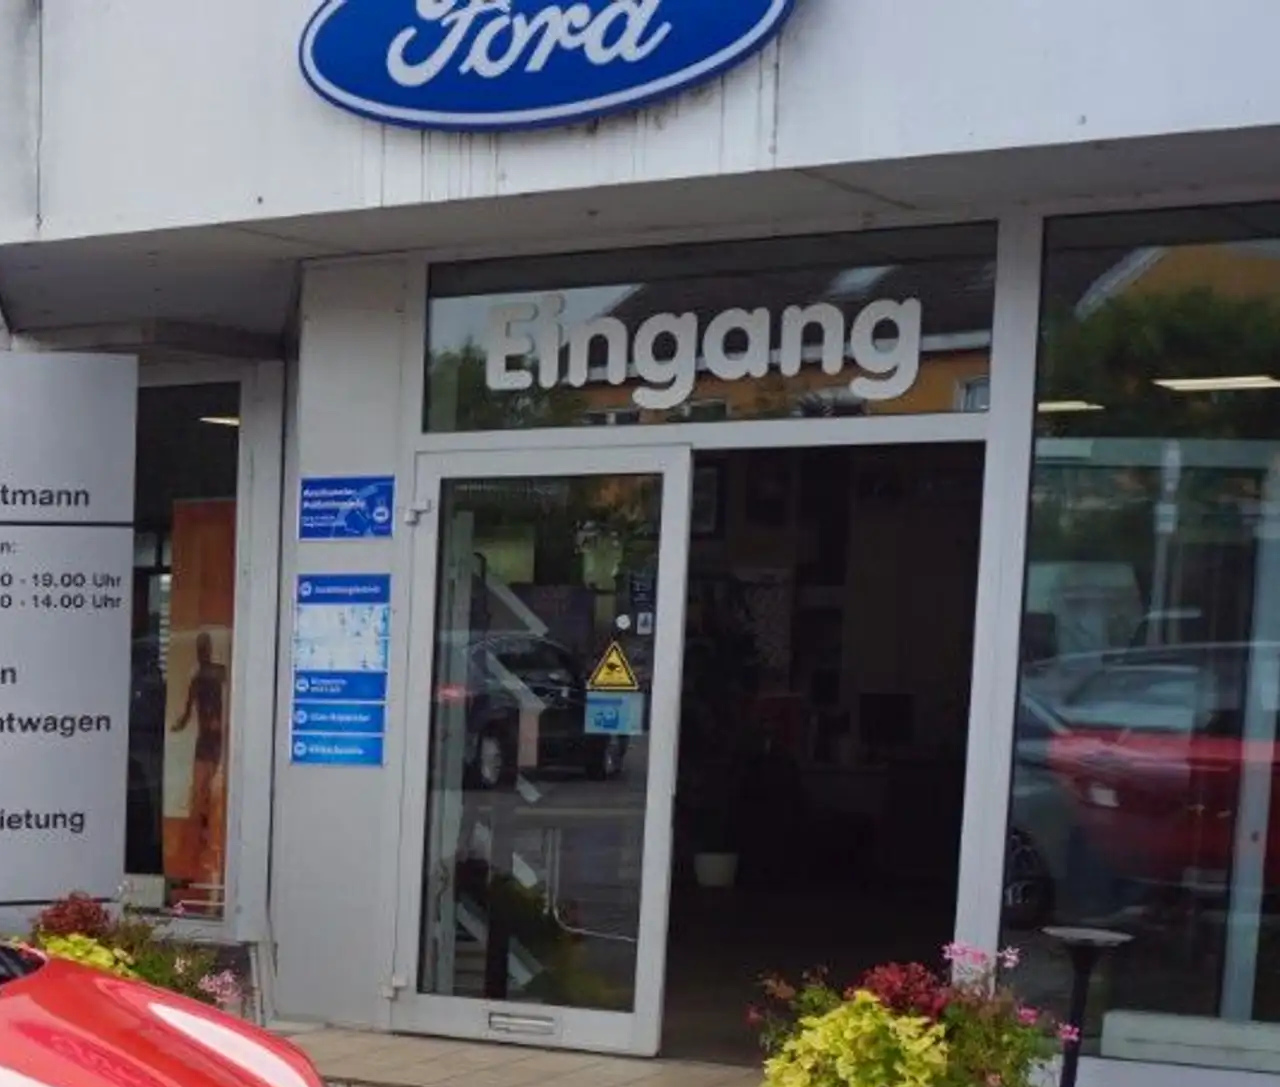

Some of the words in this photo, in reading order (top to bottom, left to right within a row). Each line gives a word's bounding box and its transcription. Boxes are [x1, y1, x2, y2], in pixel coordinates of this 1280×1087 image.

[485, 293, 922, 411] Eingang
[92, 573, 123, 588] Uhr
[32, 594, 87, 610] 14.00
[92, 595, 123, 610] Uhr
